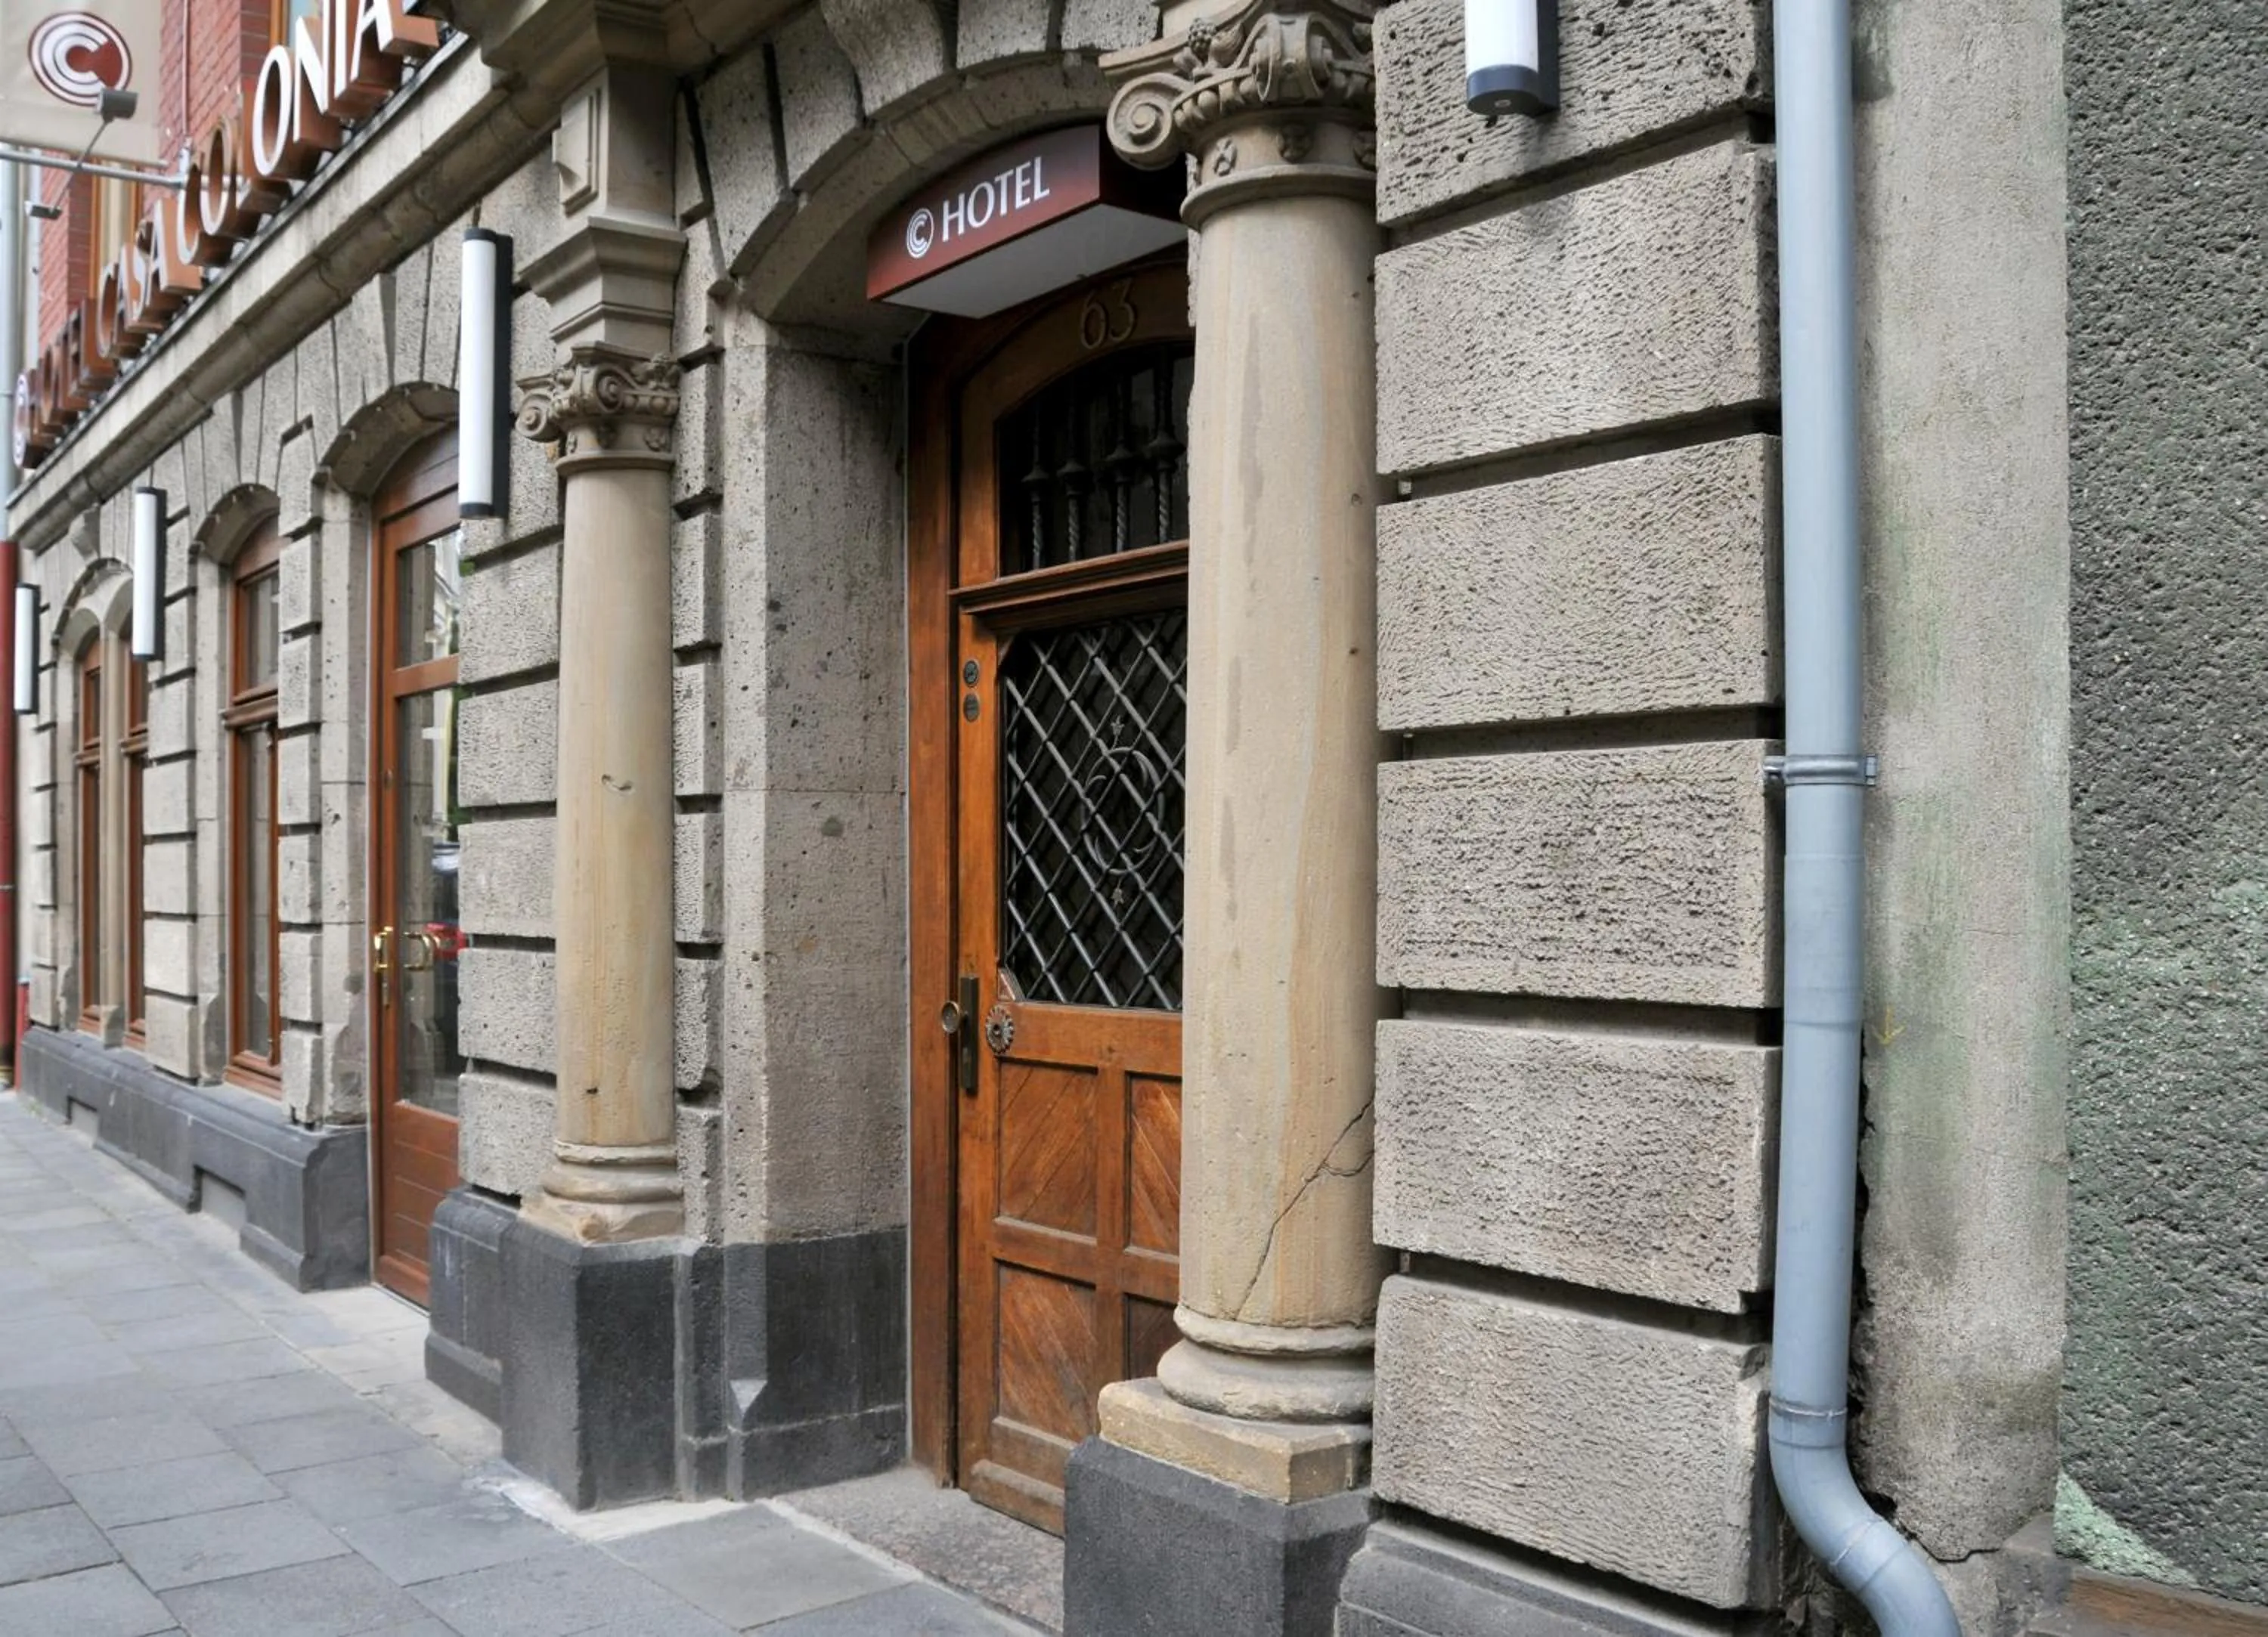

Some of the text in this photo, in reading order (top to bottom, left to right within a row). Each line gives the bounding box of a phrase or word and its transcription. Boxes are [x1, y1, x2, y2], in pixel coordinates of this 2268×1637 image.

[97, 198, 167, 358] CASA
[177, 0, 393, 265] COLONIA
[942, 156, 1050, 242] HOTEL
[1080, 277, 1136, 350] 63
